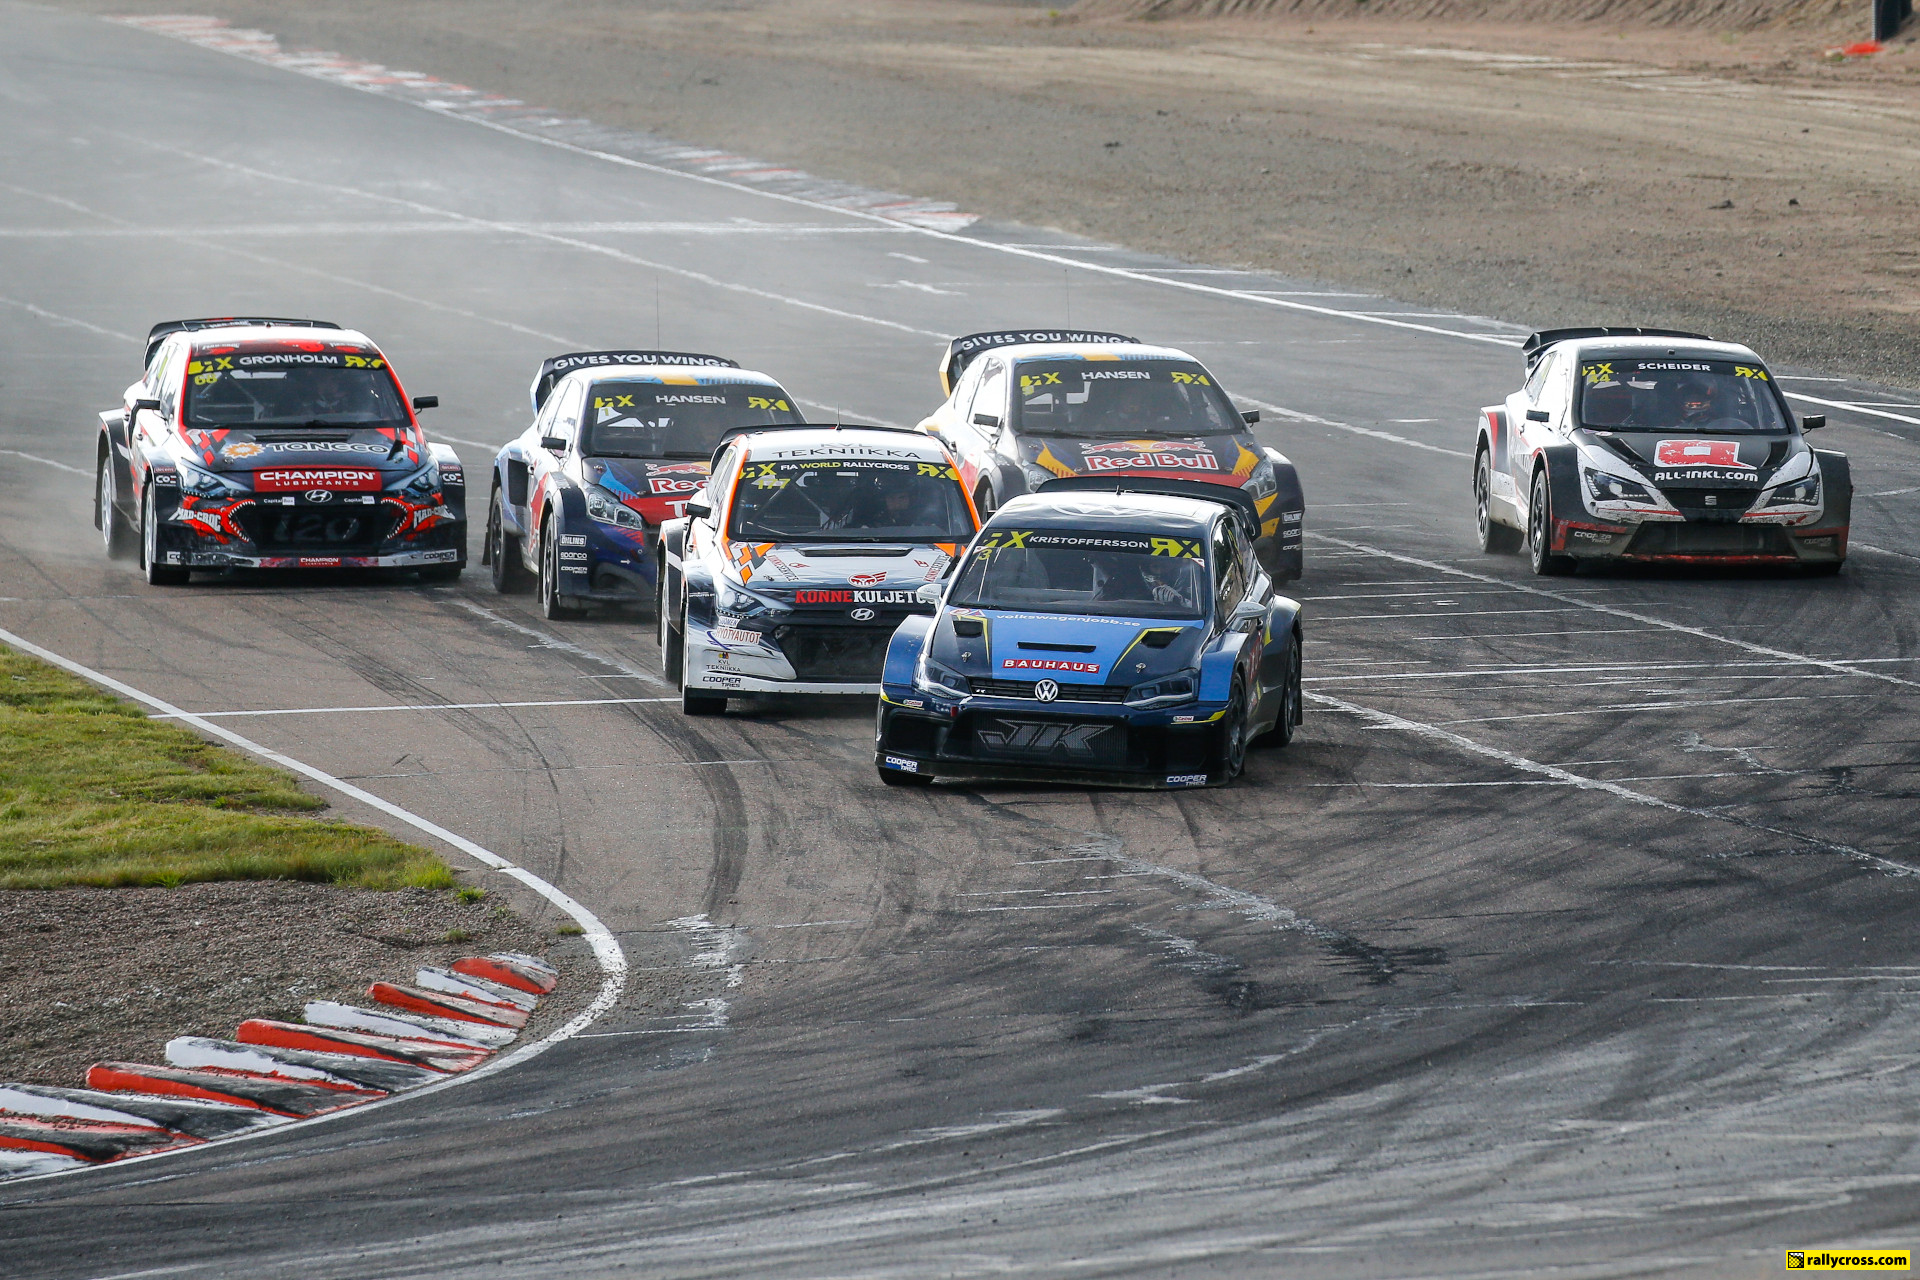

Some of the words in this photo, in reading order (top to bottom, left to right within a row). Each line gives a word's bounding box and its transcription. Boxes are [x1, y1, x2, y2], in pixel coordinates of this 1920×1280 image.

[960, 332, 1016, 351] GIVES
[1019, 332, 1062, 342] YOU
[239, 355, 338, 366] GRONHOLM
[553, 354, 610, 370] GIVES
[613, 353, 657, 364] YOU
[1637, 362, 1711, 372] SCHEIDER
[1081, 371, 1151, 380] HANSEN
[656, 394, 727, 405] HANSEN
[771, 447, 922, 460] TEKNIIKKA
[800, 462, 841, 470] WORLD
[843, 461, 910, 471] RALLYCROSS
[1084, 453, 1154, 471] Red
[1155, 452, 1220, 471] Bull
[260, 470, 375, 481] CHAMPION
[756, 478, 791, 490] 177
[1028, 535, 1149, 549] KRISTOFFERSSON
[978, 549, 993, 561] 3
[996, 612, 1141, 628] volkswagenjobb.se
[706, 664, 741, 672] TEKNIIKKA
[1004, 659, 1099, 673] BAUHAUS
[886, 756, 918, 767] COOPER
[1166, 774, 1208, 783] COOPER
